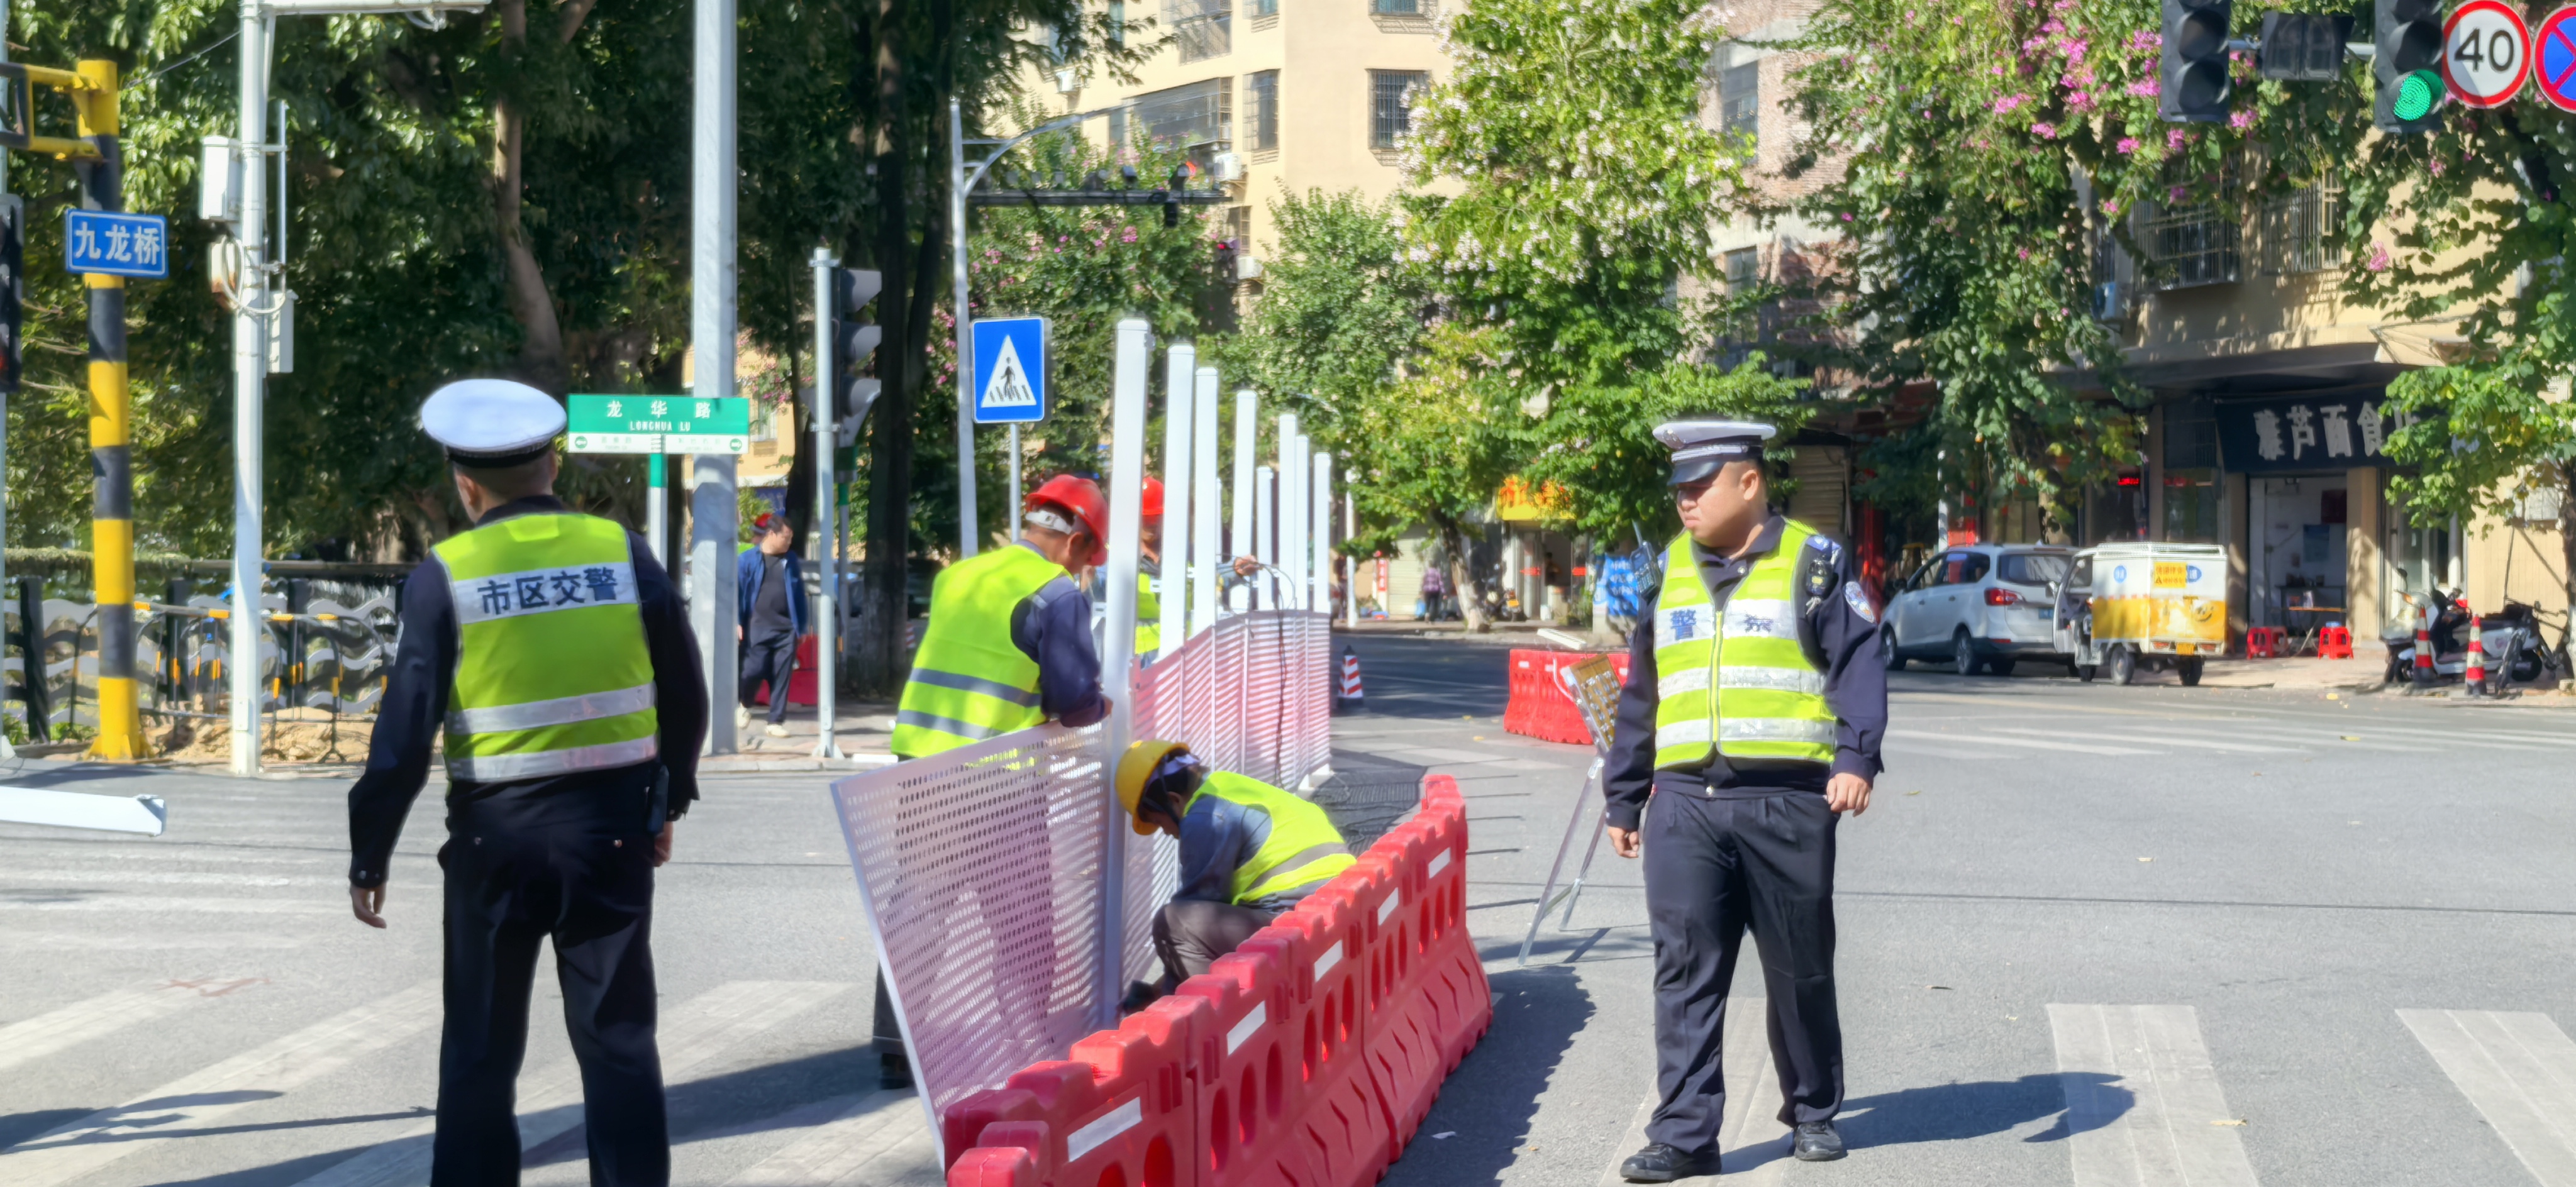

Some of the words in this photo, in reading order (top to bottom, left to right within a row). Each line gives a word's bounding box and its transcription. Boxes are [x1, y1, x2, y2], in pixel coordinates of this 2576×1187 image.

[2454, 28, 2514, 72] 40
[74, 221, 160, 265] 九龙桥
[607, 400, 711, 419] 龙华路
[630, 421, 672, 431] LONGHUA
[679, 421, 691, 432] LU
[477, 567, 618, 615] 市区交警
